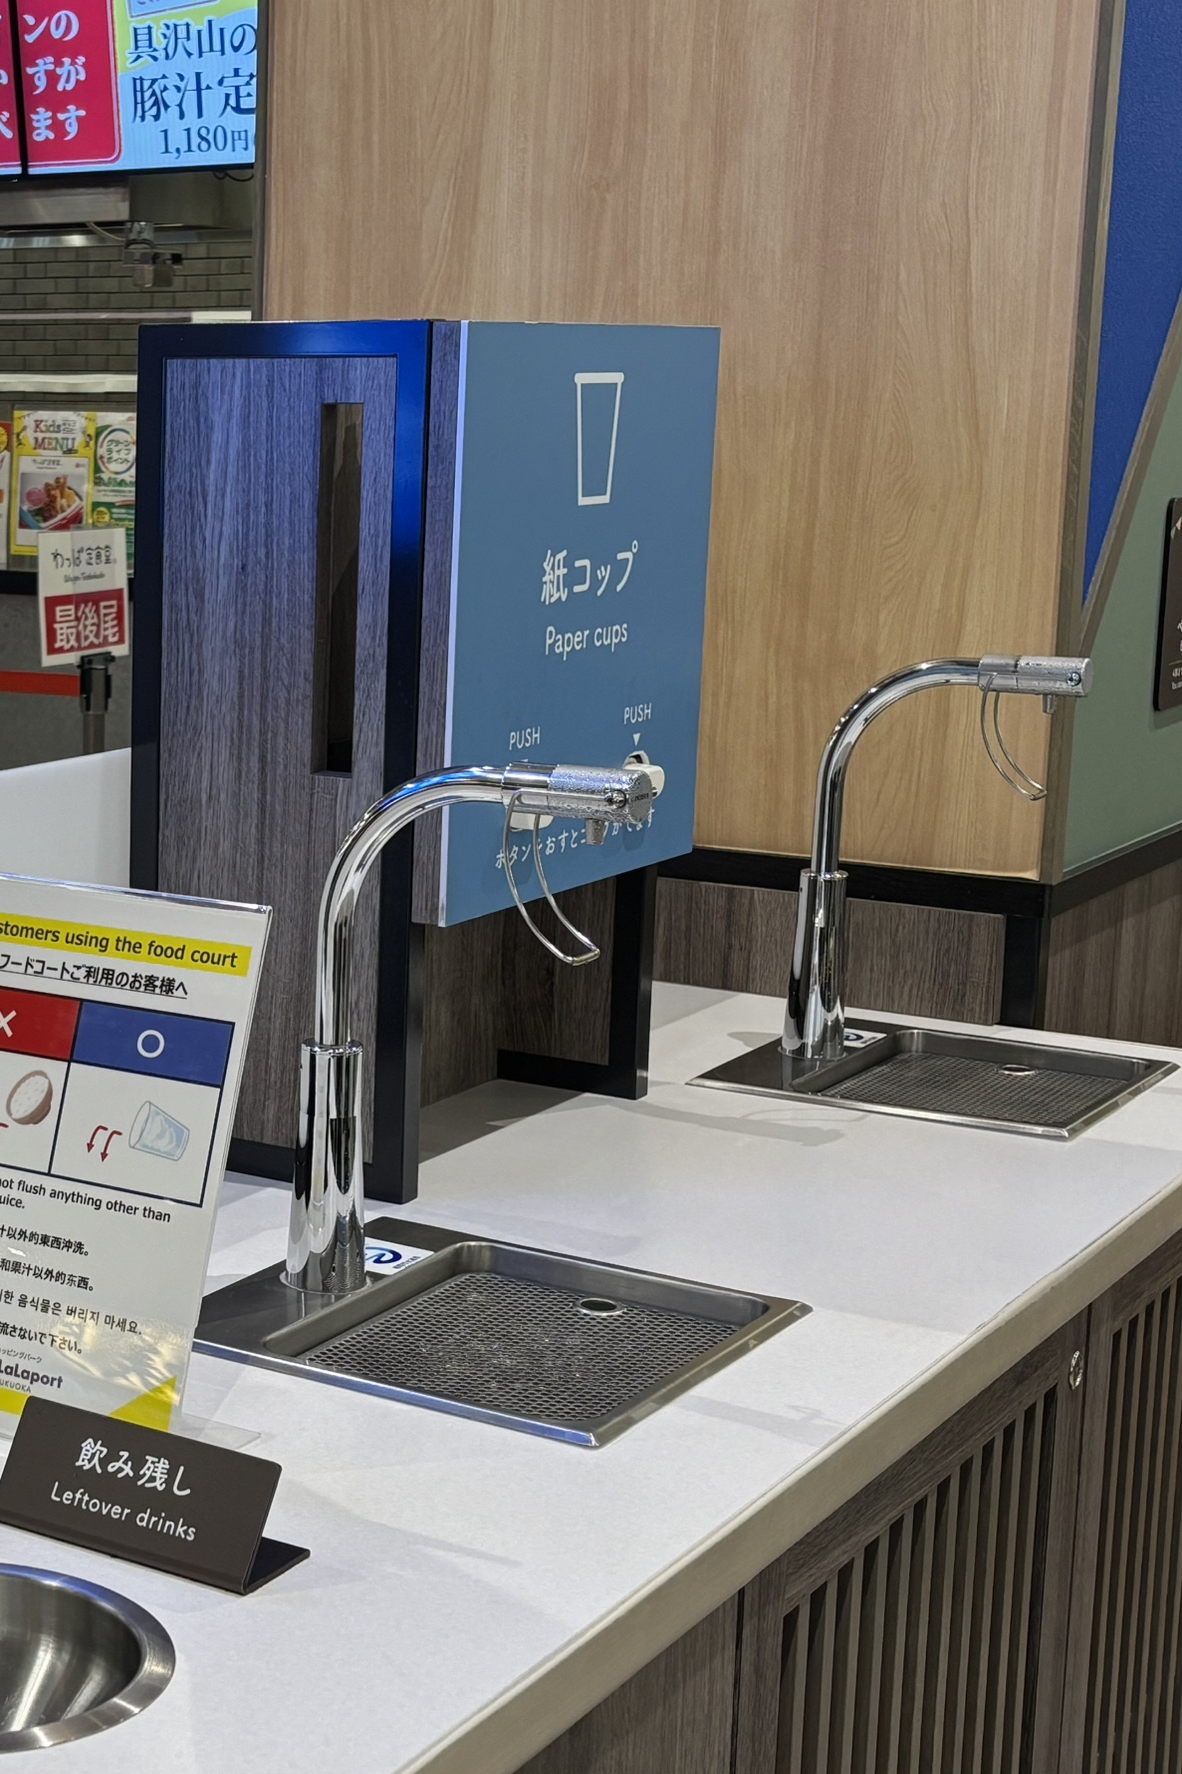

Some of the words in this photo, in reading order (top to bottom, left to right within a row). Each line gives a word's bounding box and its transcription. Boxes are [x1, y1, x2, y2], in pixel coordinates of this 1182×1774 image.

[33, 419, 63, 433] Kids
[33, 436, 77, 451] MENU
[541, 539, 639, 606] 紙コップ
[53, 600, 121, 650] 最後尾
[545, 625, 590, 661] Paper
[594, 623, 628, 652] cups
[623, 702, 653, 725] PUSH
[509, 726, 541, 750] PUSH
[64, 930, 110, 953] using
[114, 936, 143, 955] the
[146, 940, 187, 961] food
[190, 947, 238, 968] court
[17, 1179, 46, 1197] flush
[49, 1188, 103, 1211] anything
[105, 1199, 140, 1217] other
[142, 1206, 171, 1223] than
[17, 1293, 62, 1316] 음식물은
[66, 1305, 100, 1326] 버리지
[103, 1314, 142, 1335] 마세요.
[74, 1436, 193, 1497] 飲み残し
[50, 1480, 132, 1522] Leftover
[135, 1507, 197, 1543] drinks
